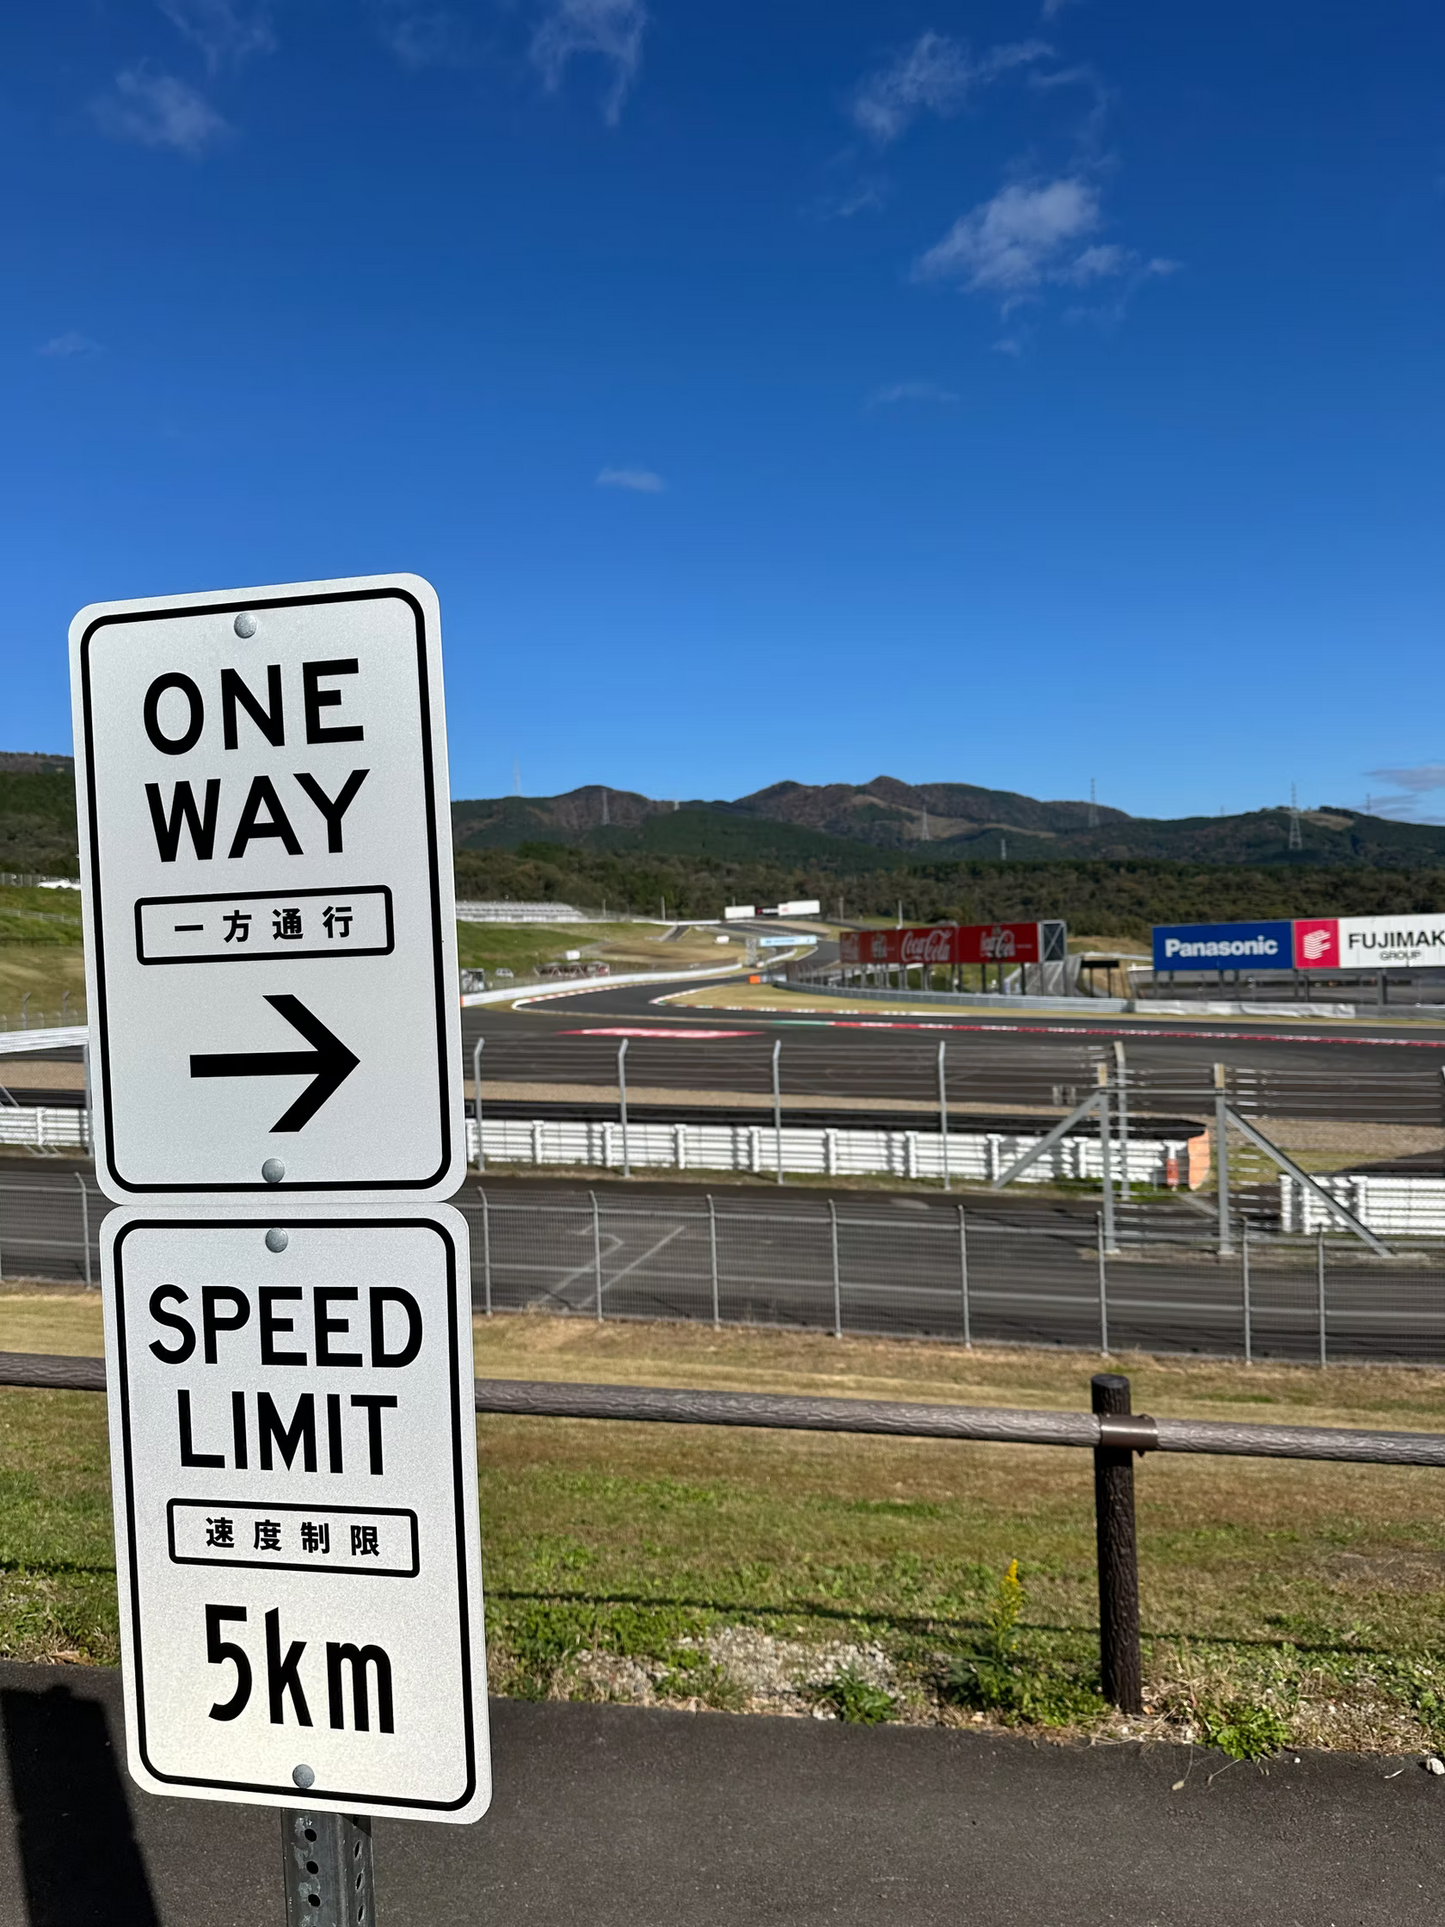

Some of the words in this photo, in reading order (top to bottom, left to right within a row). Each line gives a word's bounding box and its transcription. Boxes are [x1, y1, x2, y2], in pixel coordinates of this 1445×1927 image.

[143, 657, 365, 756] ONE
[144, 768, 371, 863] WAY
[174, 905, 355, 944] 一方通行
[1164, 935, 1279, 958] Panasonic
[1348, 930, 1445, 949] FUJIMAK
[1379, 950, 1421, 961] GROUP
[148, 1283, 423, 1369] SPEED
[177, 1389, 398, 1476] LIMIT
[205, 1516, 380, 1557] 速度制限
[204, 1603, 395, 1735] 5km
